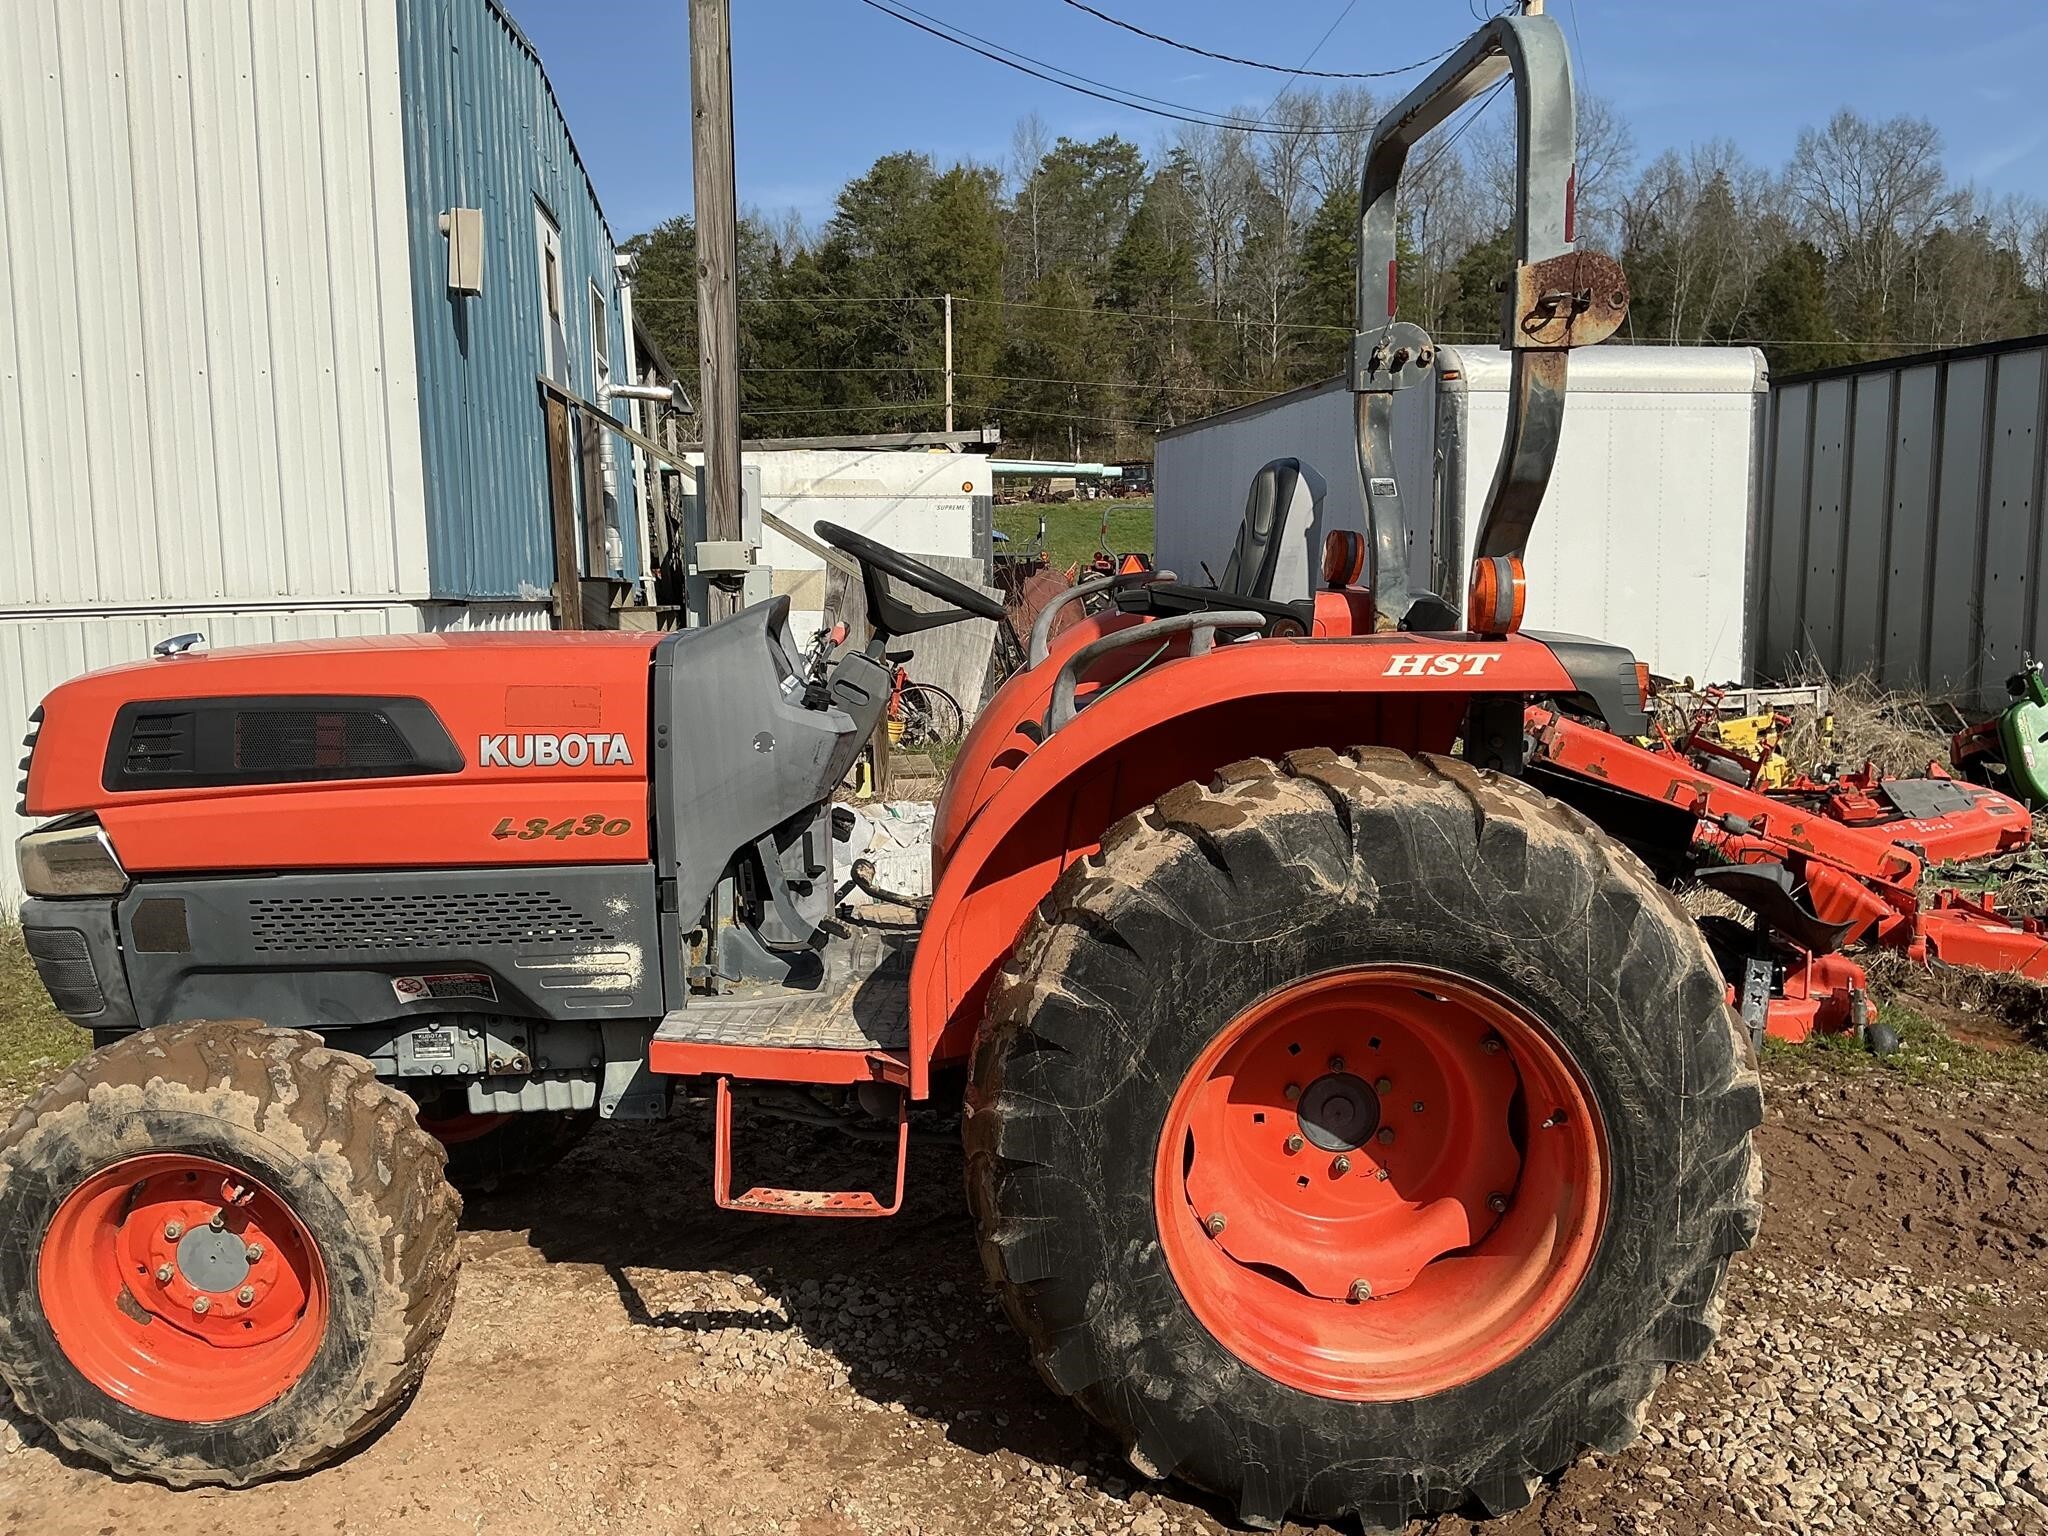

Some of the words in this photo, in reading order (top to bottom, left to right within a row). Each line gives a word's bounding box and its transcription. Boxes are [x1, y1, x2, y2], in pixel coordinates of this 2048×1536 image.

[1381, 653, 1502, 676] HST
[479, 733, 634, 767] KUBOTA
[491, 814, 632, 841] L3430
